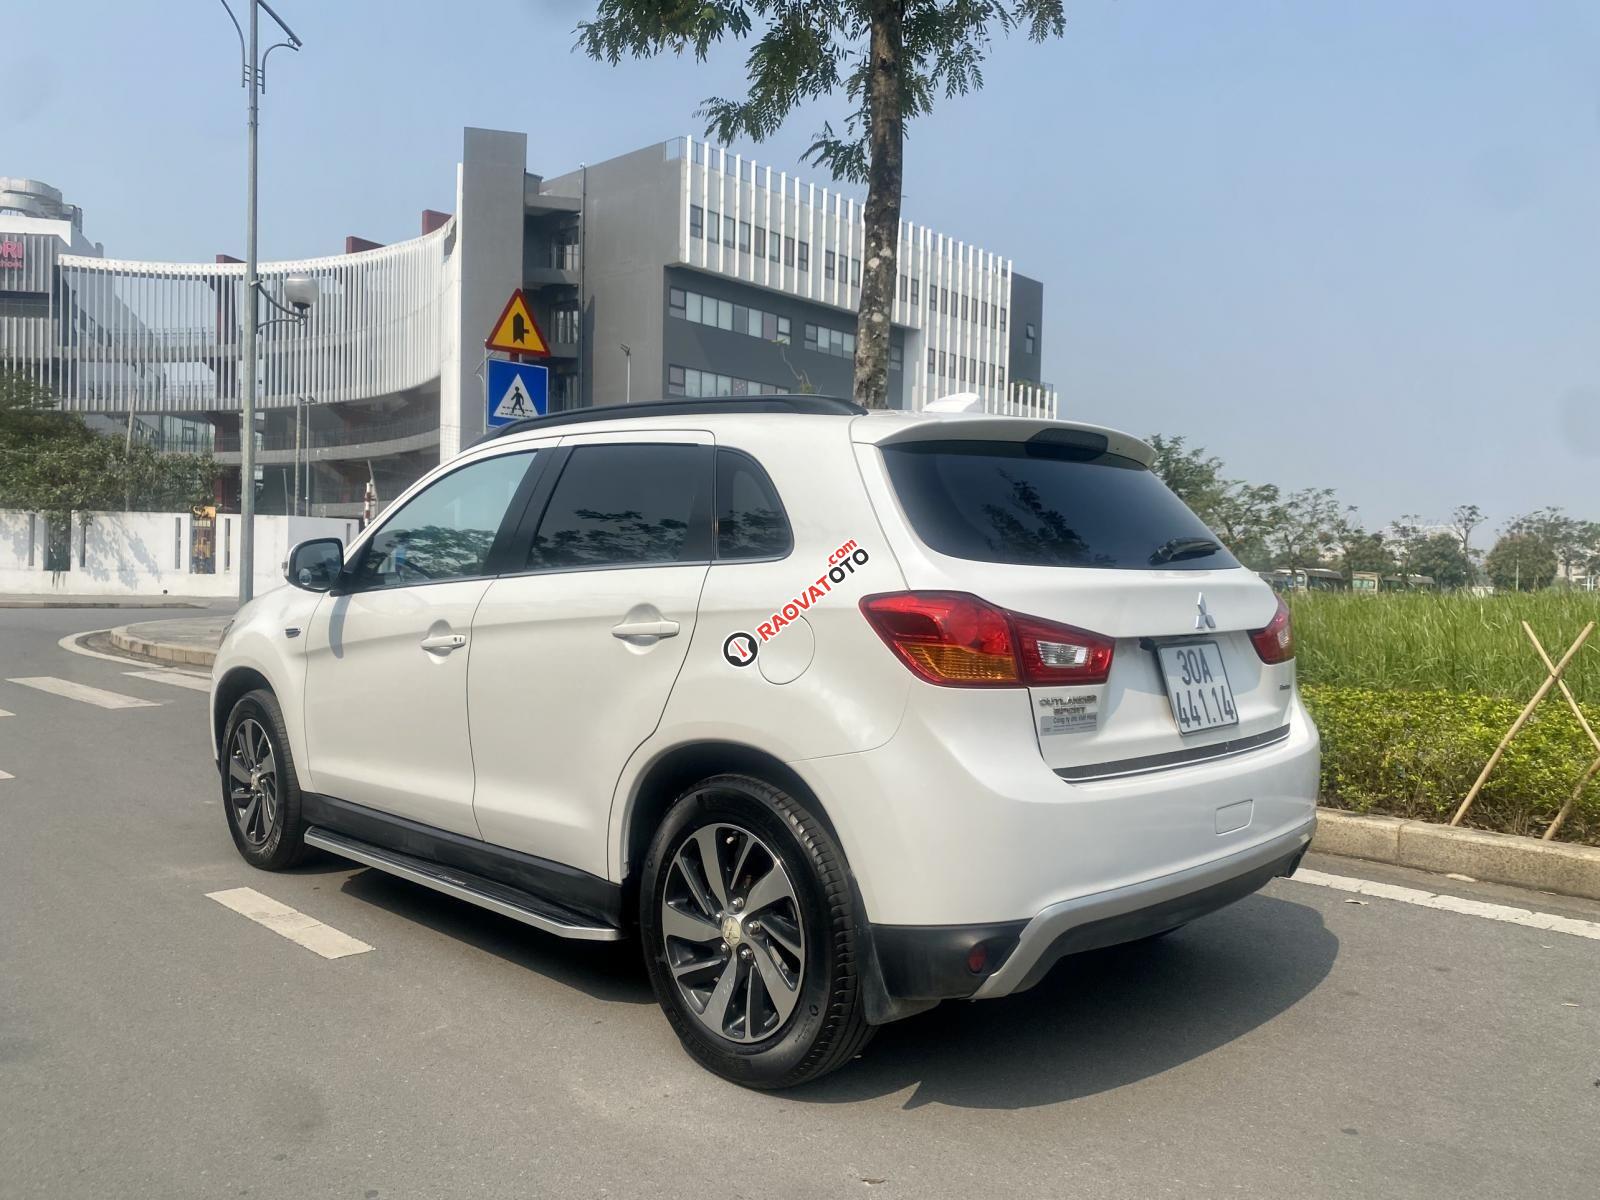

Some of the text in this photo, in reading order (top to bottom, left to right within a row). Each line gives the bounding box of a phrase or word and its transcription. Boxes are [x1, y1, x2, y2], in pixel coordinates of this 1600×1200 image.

[0, 241, 23, 258] RI
[1176, 647, 1213, 685] 30A
[1176, 685, 1234, 728] 441.14
